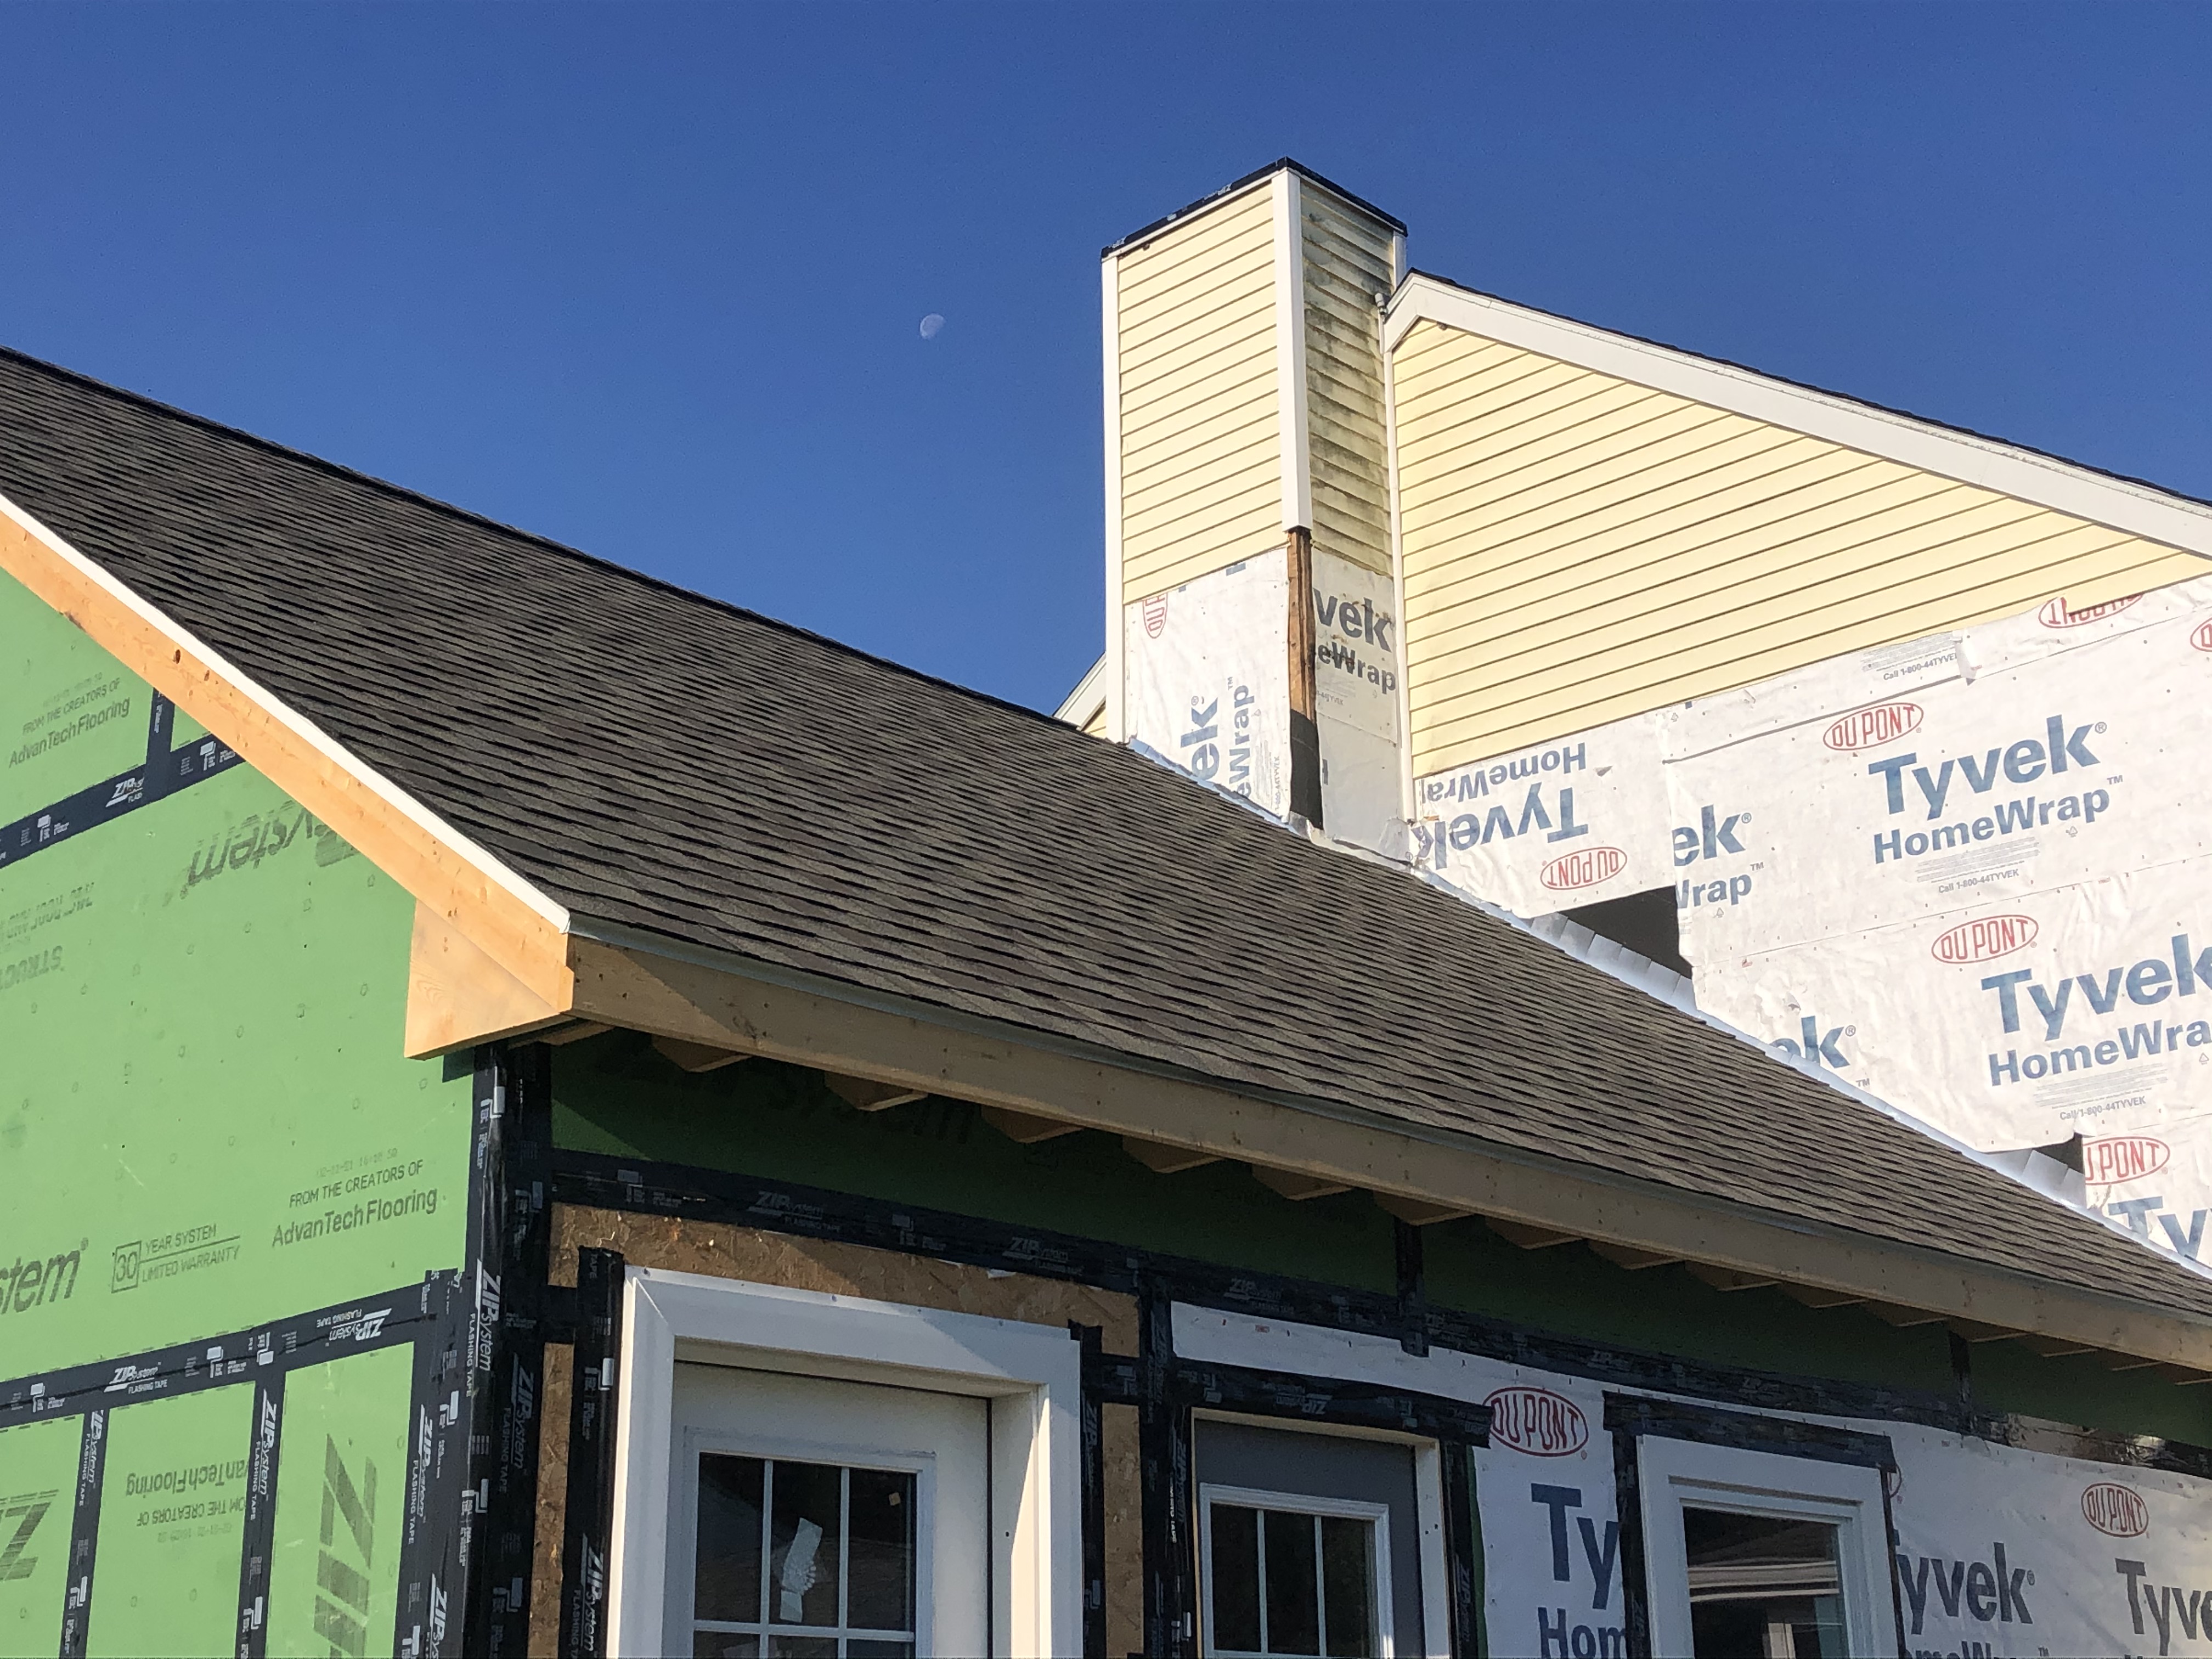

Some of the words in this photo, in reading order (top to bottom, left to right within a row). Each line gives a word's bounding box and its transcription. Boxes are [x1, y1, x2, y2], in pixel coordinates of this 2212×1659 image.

[109, 677, 121, 693] OF
[1883, 669, 1899, 681] Call
[1938, 882, 1954, 894] Call
[289, 1188, 320, 1209] FROM
[322, 1181, 343, 1199] THE
[345, 1164, 405, 1194] CREATORS
[408, 1158, 424, 1177] OF
[145, 1235, 172, 1256] YEAR
[175, 1223, 217, 1248] SYSTEM
[116, 1251, 138, 1283] 30
[142, 1261, 178, 1283] LIMITED
[181, 1245, 241, 1273] WARRANTY
